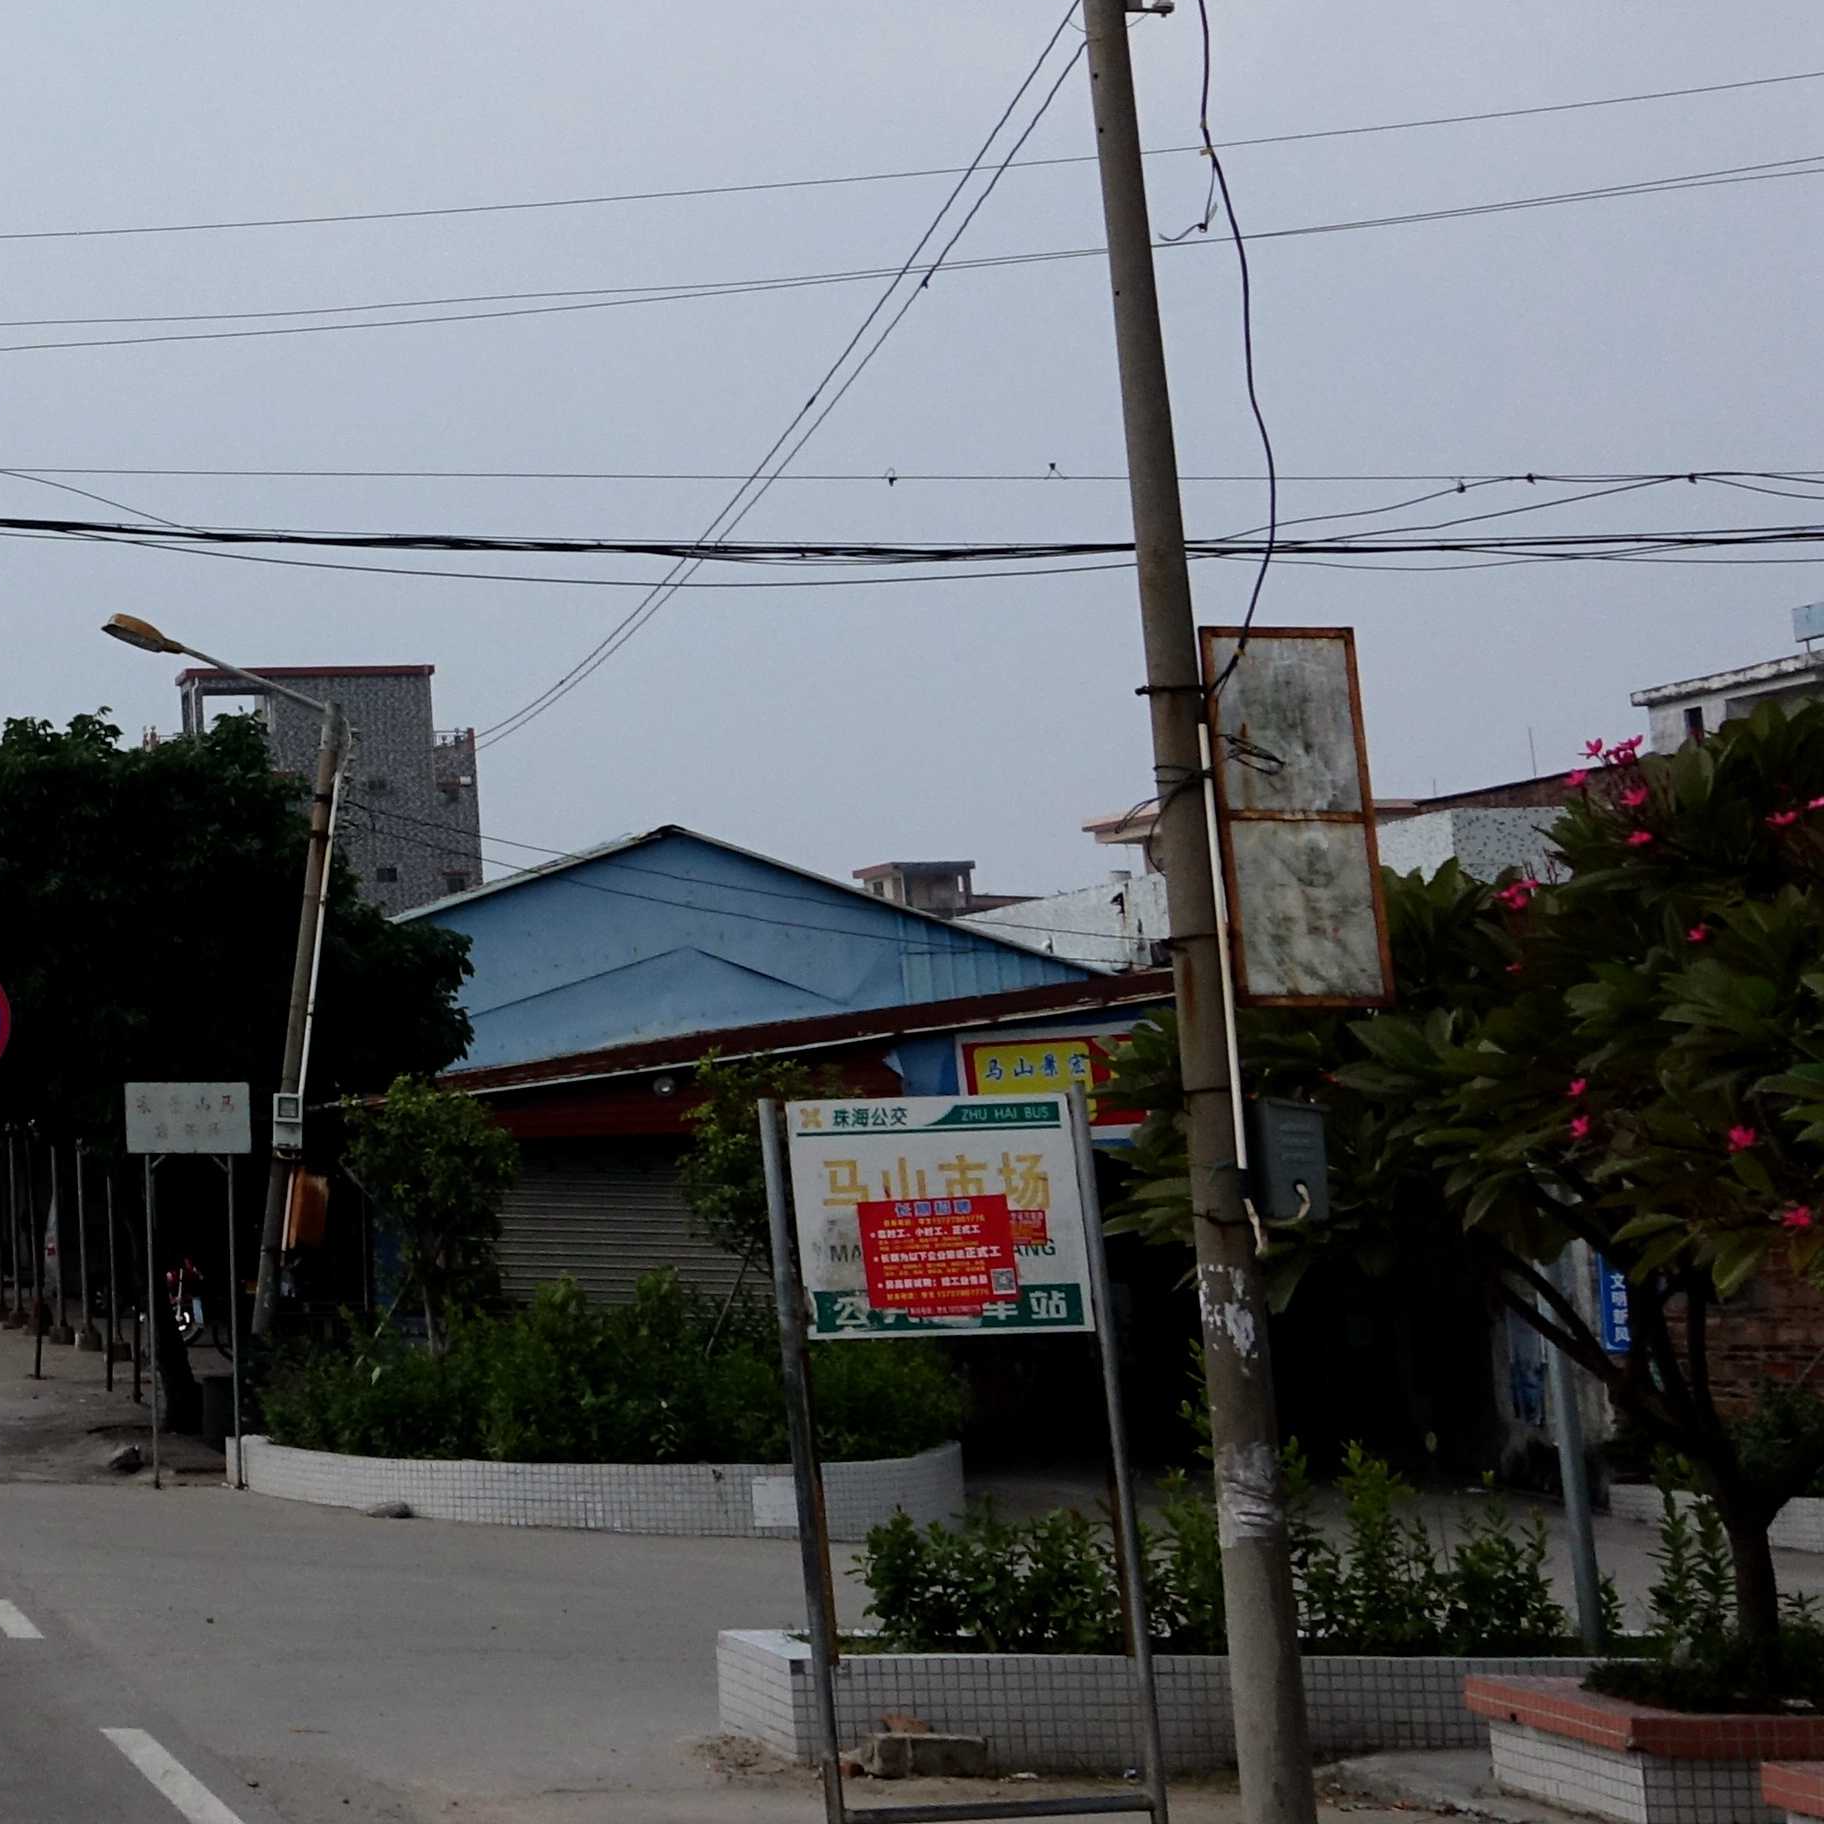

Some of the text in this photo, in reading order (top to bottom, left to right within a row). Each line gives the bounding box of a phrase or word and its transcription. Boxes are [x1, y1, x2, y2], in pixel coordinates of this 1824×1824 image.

[832, 1106, 908, 1127] 珠海公交
[961, 1105, 1049, 1121] ZHU HAI BUS
[823, 1151, 1050, 1209] 马山市场
